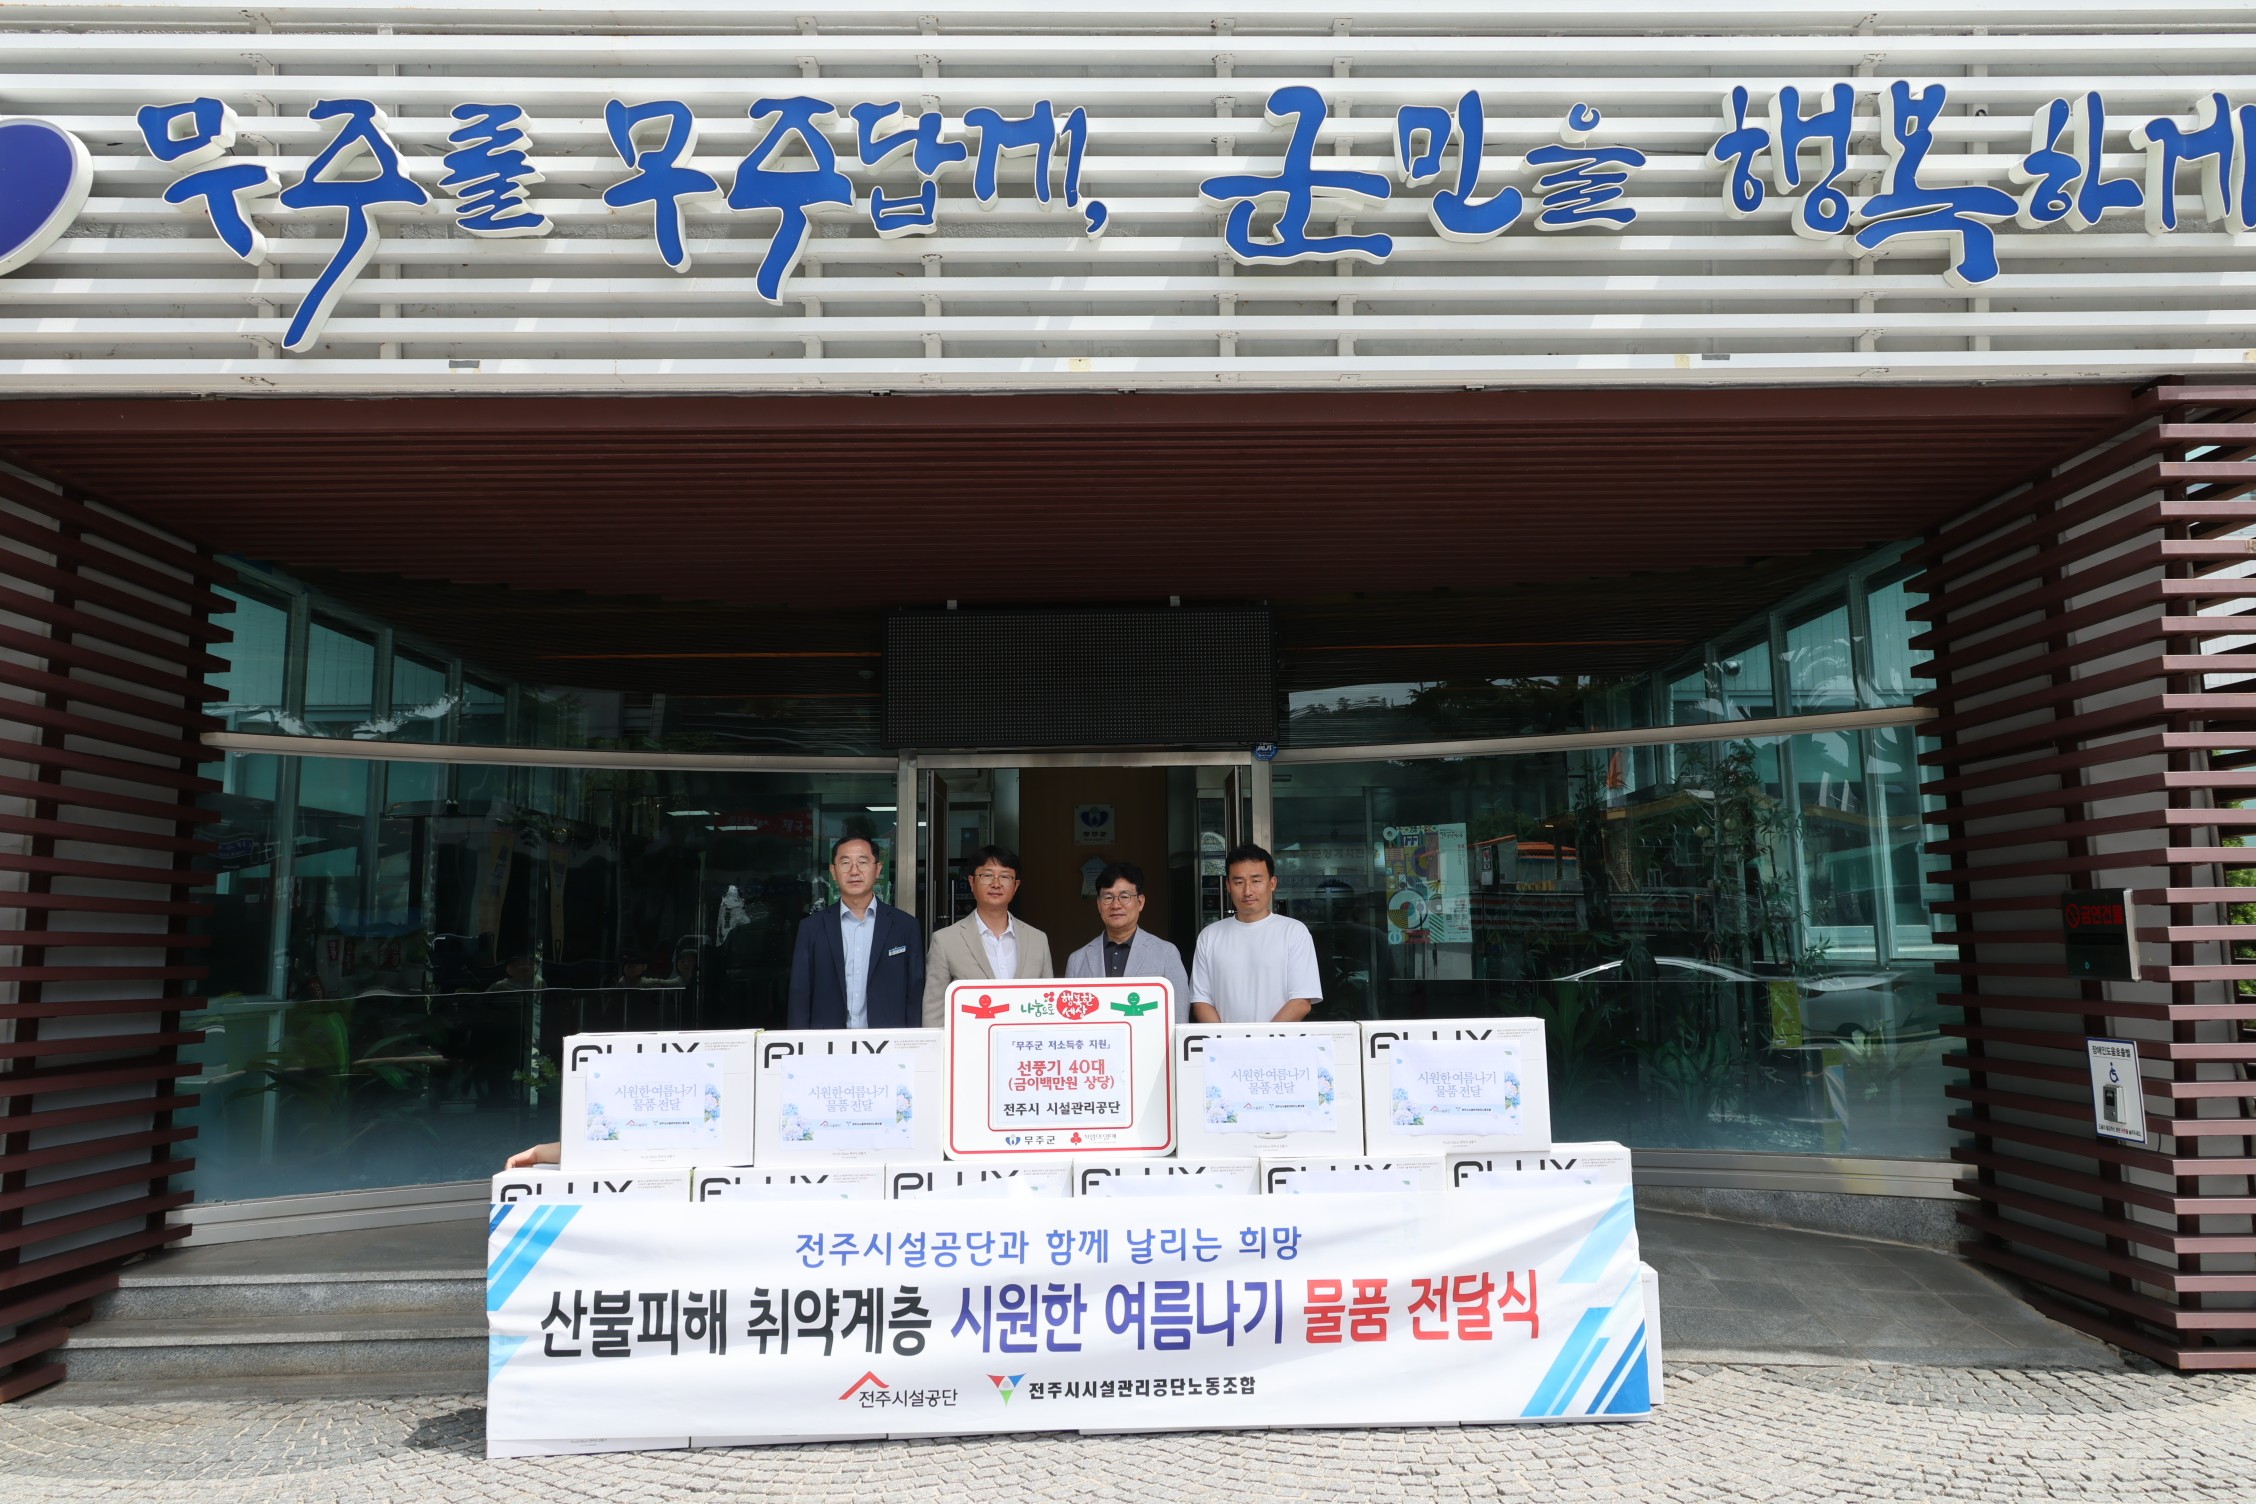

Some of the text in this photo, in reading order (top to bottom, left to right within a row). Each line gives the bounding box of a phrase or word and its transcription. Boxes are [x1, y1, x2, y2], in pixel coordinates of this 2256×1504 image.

[137, 80, 2256, 350] 무주를 무주답게, 군민을 행복하게
[1021, 991, 1095, 1018] 나눔으로 행복한
[1061, 1005, 1089, 1018] 세상
[1048, 1039, 1085, 1050] 저소득층
[1017, 1058, 1106, 1077] 선풍기 40대
[1231, 1067, 1310, 1083] 시원한 여름나기
[1008, 1075, 1115, 1091] (금이백만원 상당)
[1418, 1071, 1497, 1085] 시원한 여름나기
[614, 1083, 697, 1099] 시원한 여름나기
[808, 1084, 889, 1099] 시원한 여름나기
[1249, 1081, 1296, 1095] 물품 전달
[1435, 1084, 1482, 1098] 물품 전달
[632, 1097, 681, 1111] 물품 전달
[826, 1099, 874, 1112] 물품 전달
[1003, 1100, 1121, 1117] 전주시 시설관리공단
[1024, 1135, 1056, 1146] 무주군
[796, 1226, 1303, 1269] 전주시설공단과 함께 날리는 희망
[540, 1269, 1540, 1358] 산불피해 취약계층 시원한 여름나기 물품 전달식
[1028, 1375, 1256, 1401] 전주시시설관리공단노동조합
[858, 1388, 959, 1409] 전주시설공단
